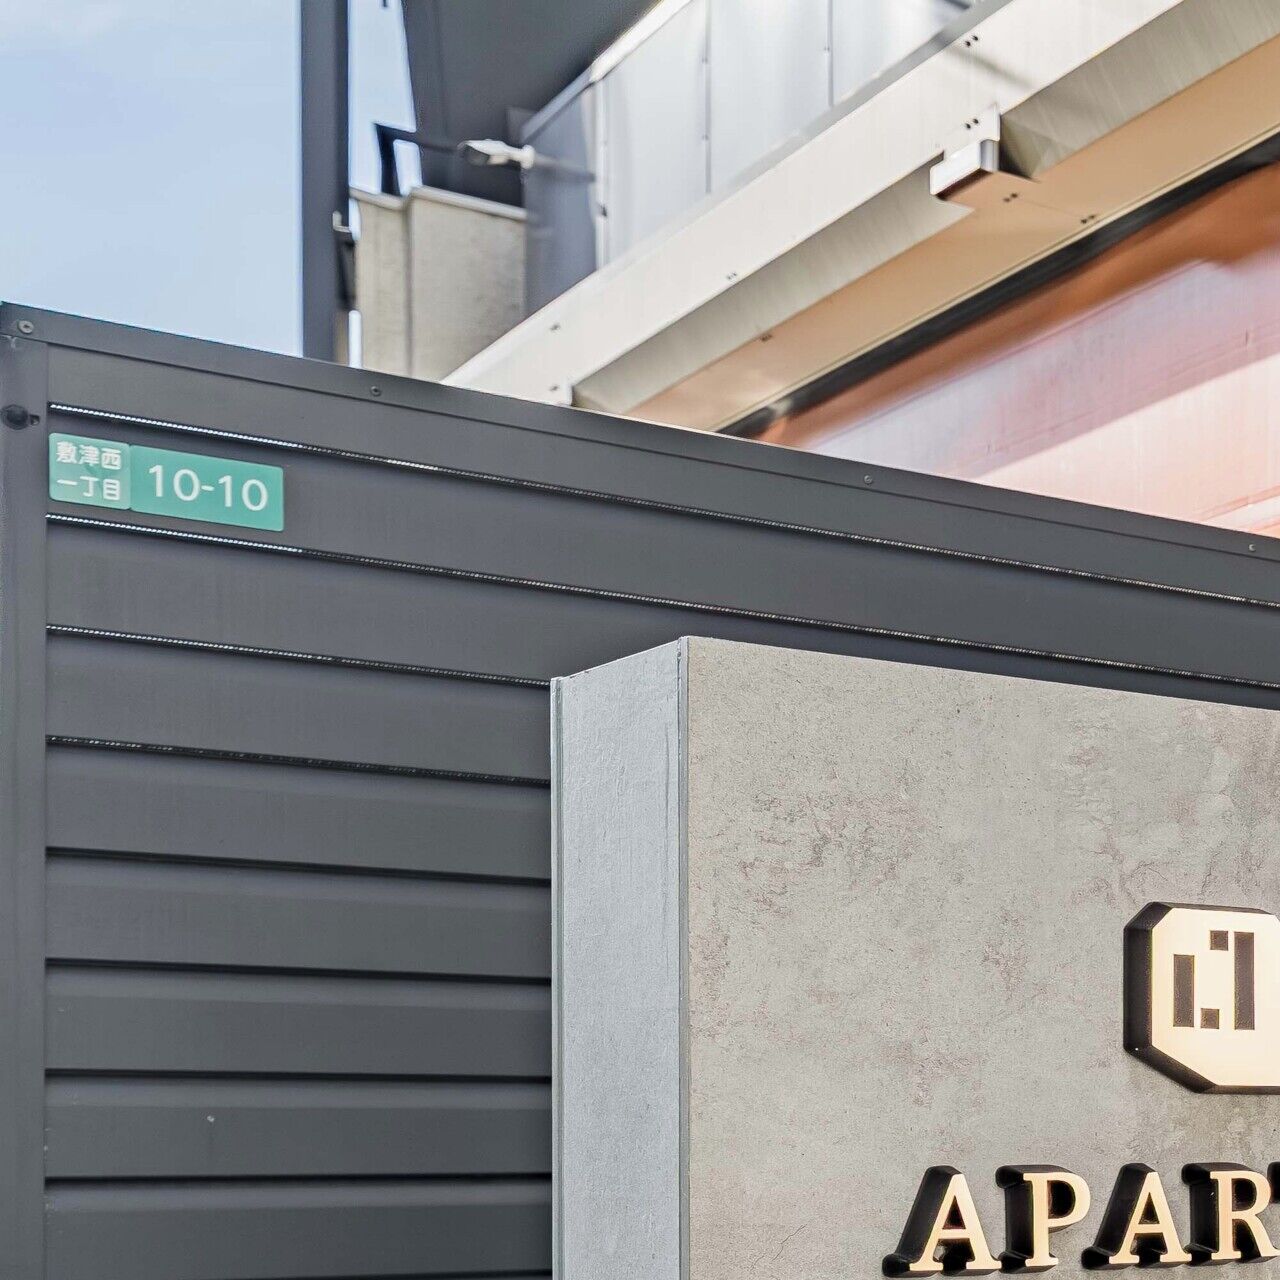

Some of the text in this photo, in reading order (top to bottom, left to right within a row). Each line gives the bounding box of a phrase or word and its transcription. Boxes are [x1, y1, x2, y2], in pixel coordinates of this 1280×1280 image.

[55, 440, 122, 471] 敷津西
[56, 474, 122, 501] 一丁目
[148, 463, 269, 512] 10-10
